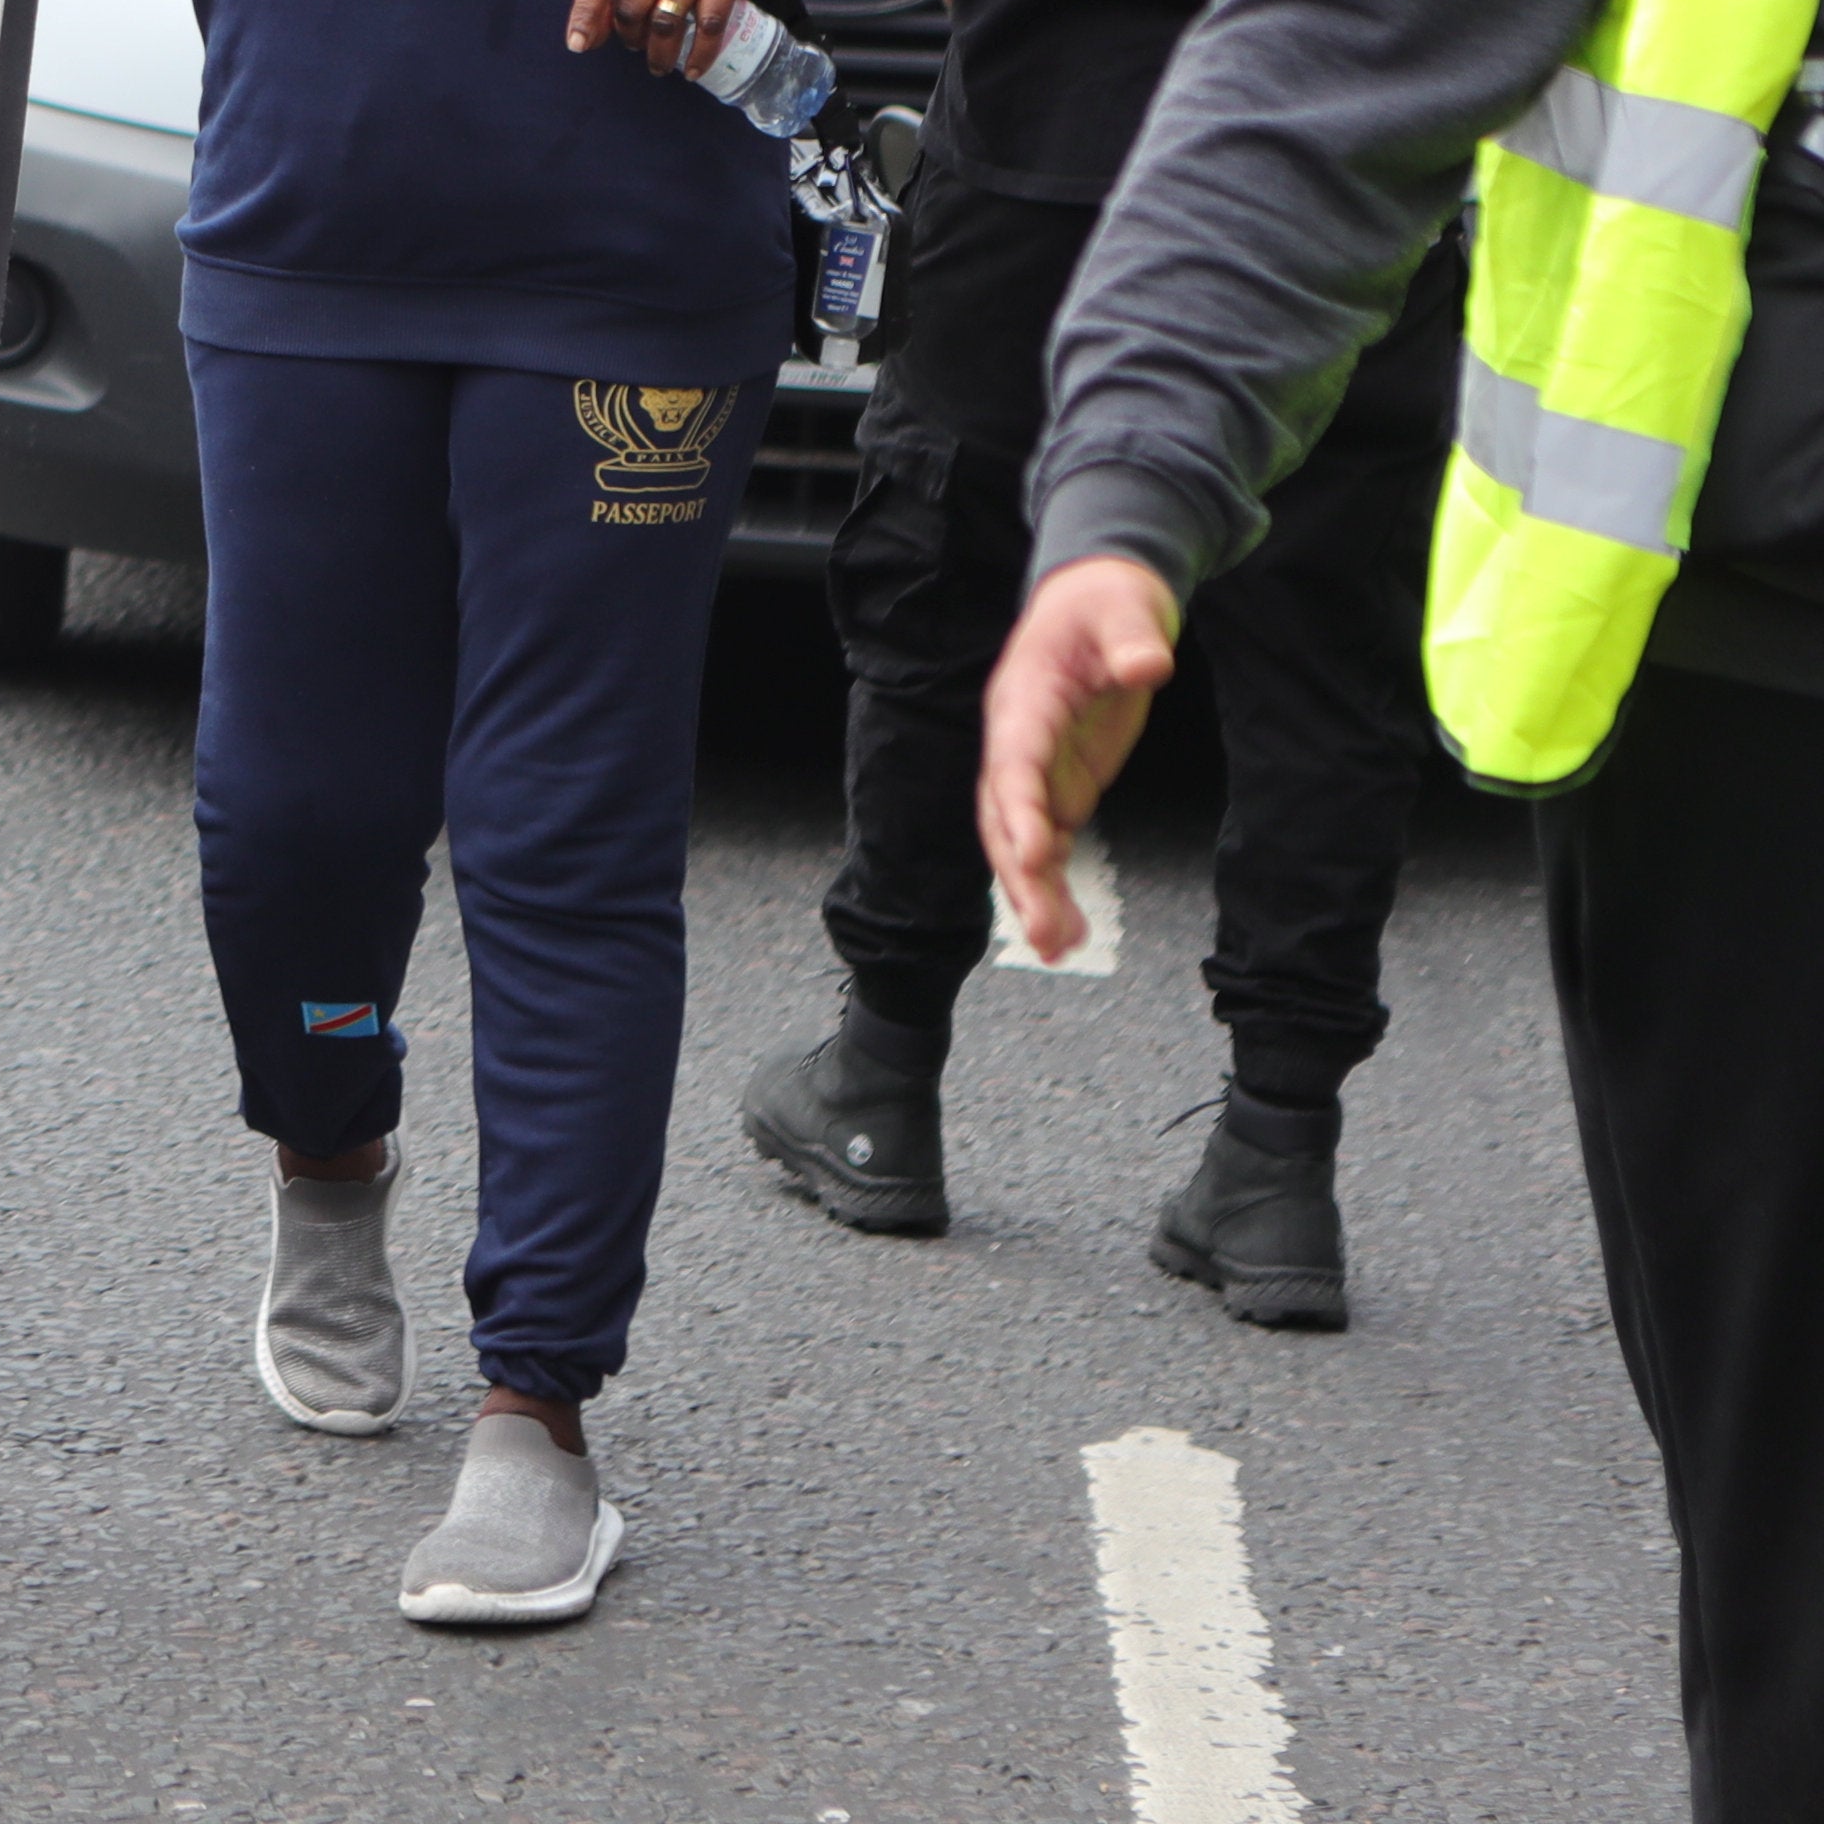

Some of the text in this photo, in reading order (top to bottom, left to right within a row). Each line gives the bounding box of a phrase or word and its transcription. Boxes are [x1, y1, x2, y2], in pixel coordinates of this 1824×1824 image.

[580, 392, 621, 445] JUSTICE
[635, 453, 684, 463] PAIX
[590, 497, 708, 525] PASSEPORT
